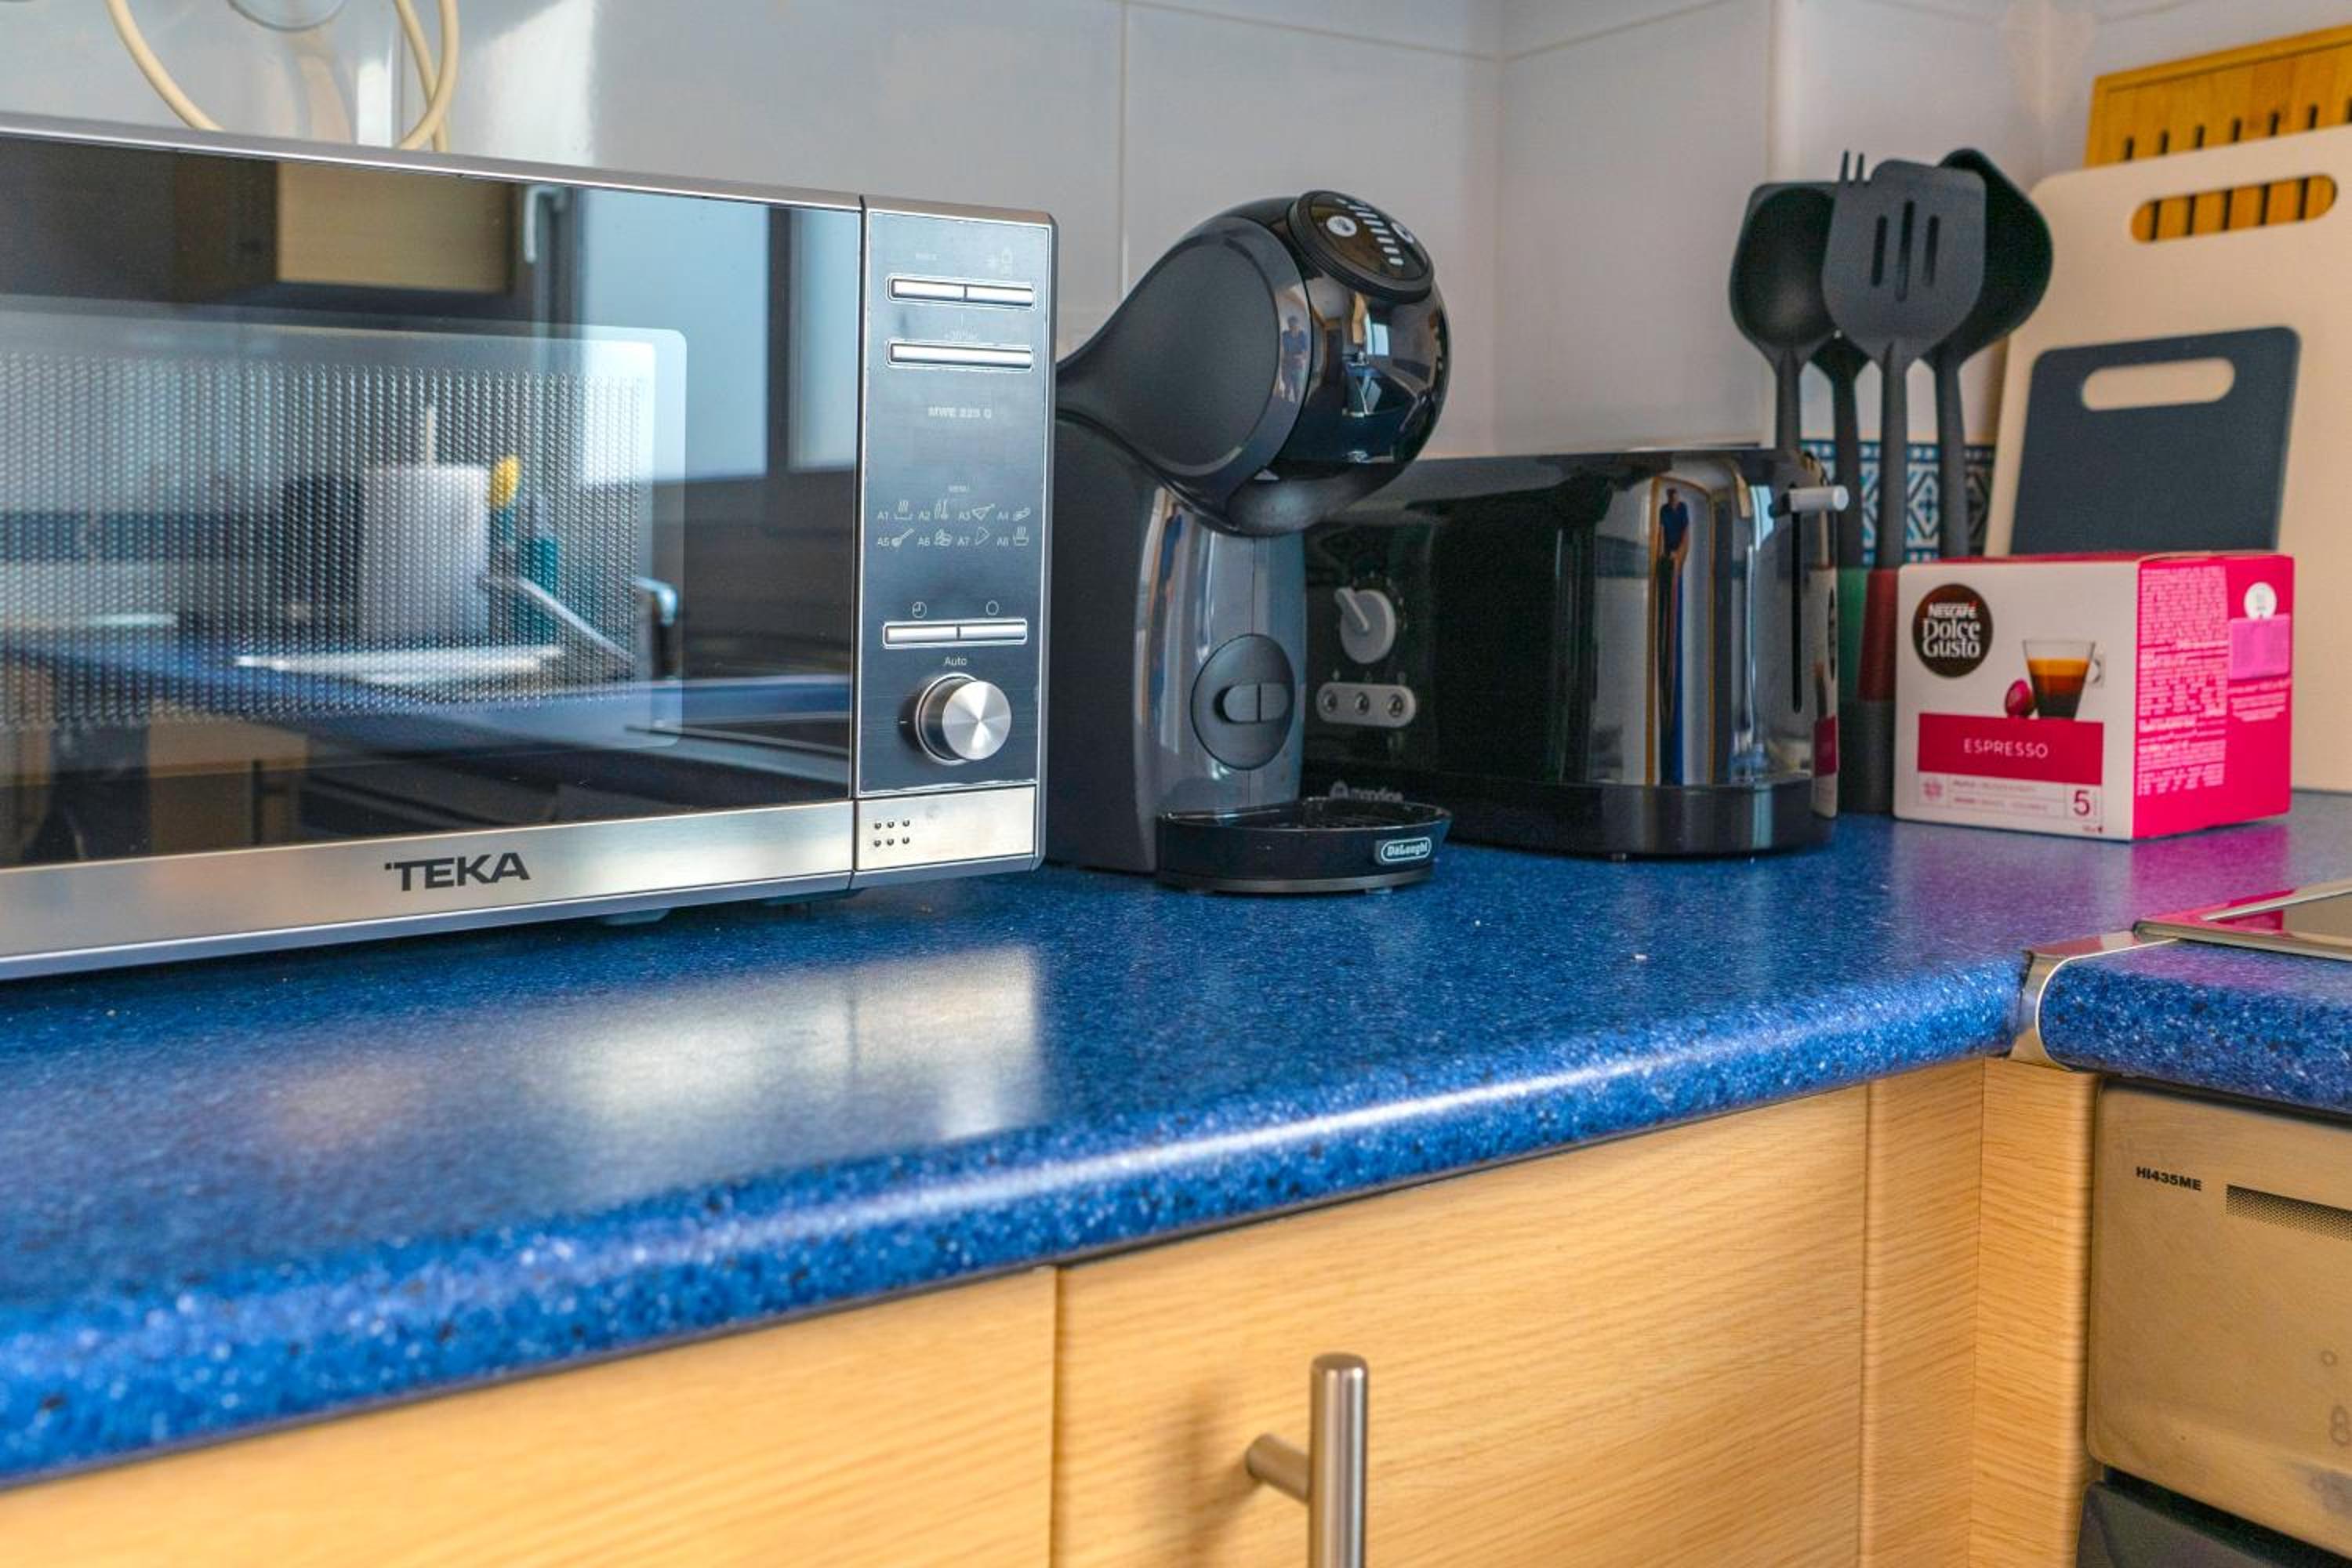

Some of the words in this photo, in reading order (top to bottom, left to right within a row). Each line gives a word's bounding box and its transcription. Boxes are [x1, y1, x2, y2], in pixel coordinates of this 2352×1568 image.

[877, 512, 888, 521] A1
[877, 537, 890, 546] A5
[957, 537, 970, 546] A7
[1922, 617, 1981, 641] Dolce
[1922, 637, 1981, 658] Gusto
[944, 656, 967, 666] Auto
[1963, 738, 2049, 760] ESPRESSO
[2073, 789, 2091, 816] 5
[394, 852, 531, 891] TEKA
[2136, 1166, 2202, 1192] HI435ME
